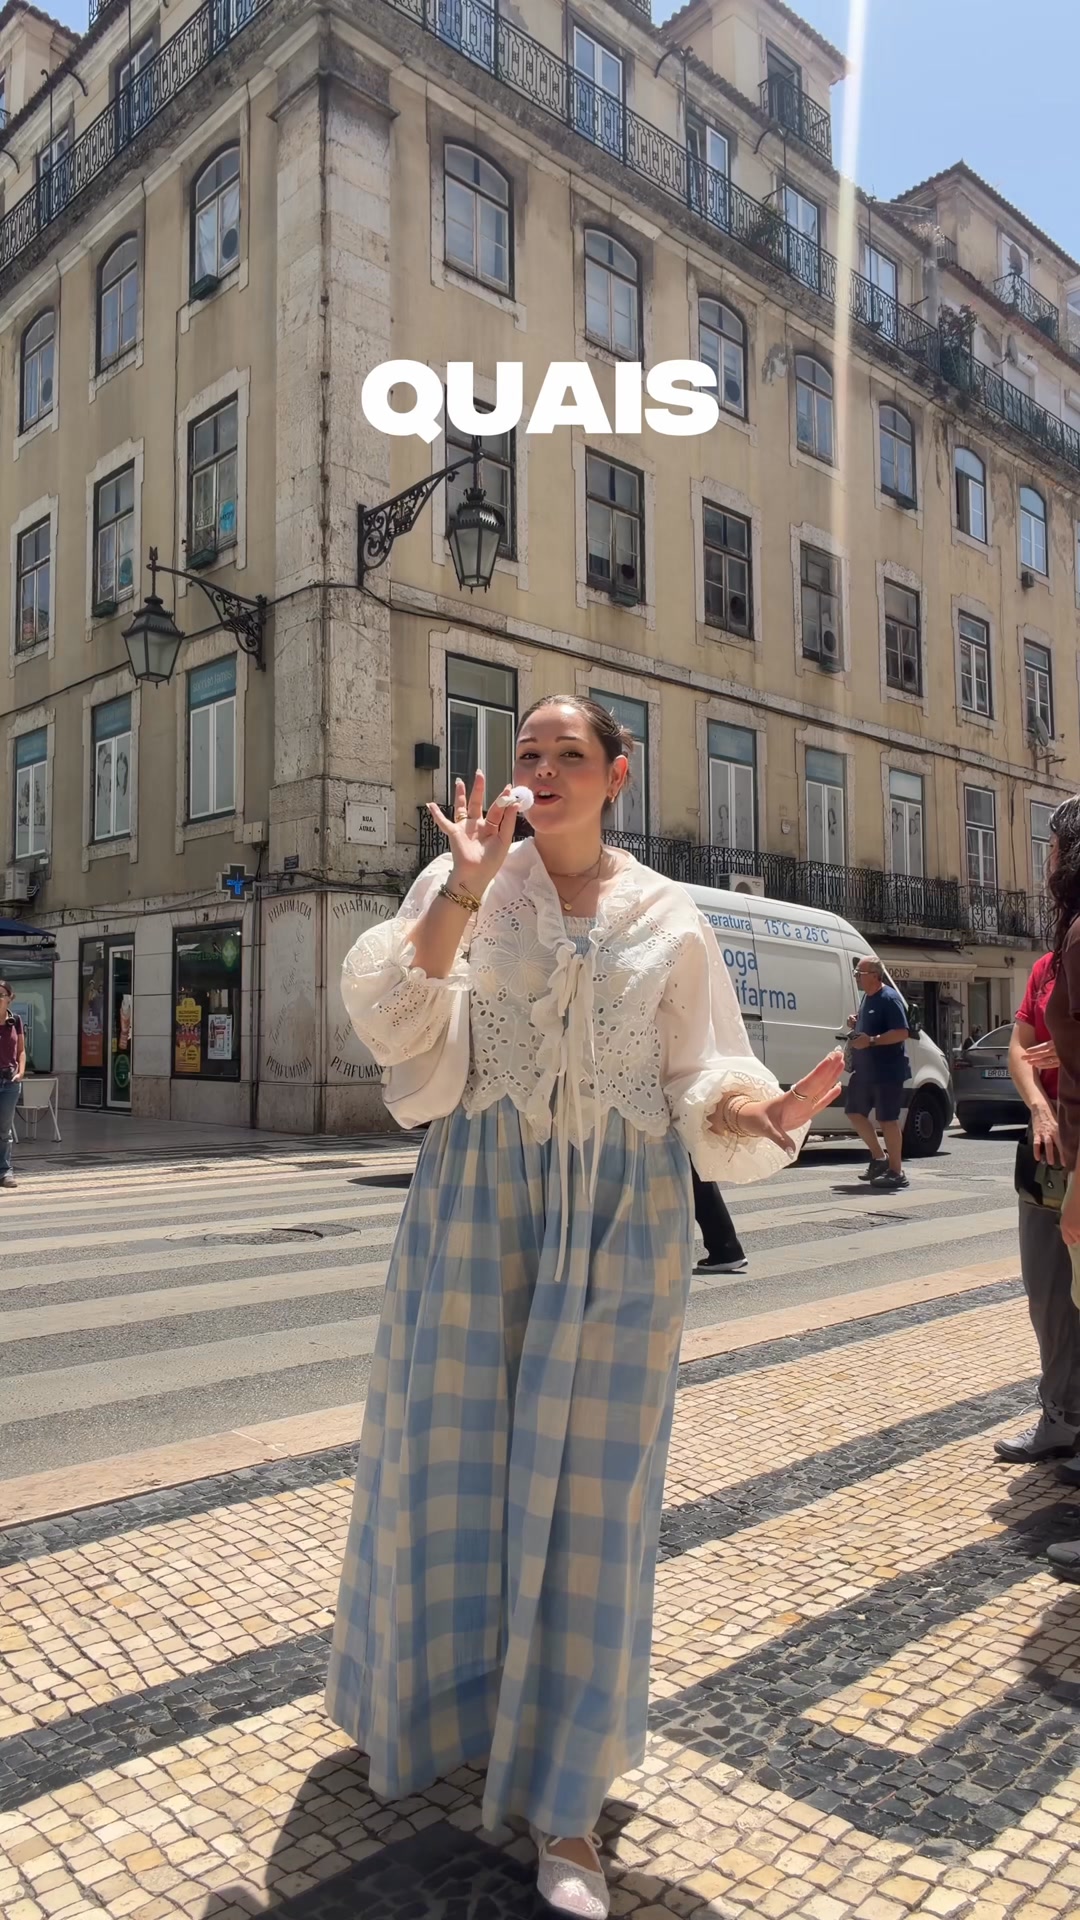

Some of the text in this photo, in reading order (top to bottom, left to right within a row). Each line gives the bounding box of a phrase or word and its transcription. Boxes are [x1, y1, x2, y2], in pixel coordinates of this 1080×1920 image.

[268, 899, 312, 923] PHARMACIA
[795, 928, 802, 940] a
[723, 948, 758, 977] oga
[735, 979, 797, 1011] ifarma
[266, 1055, 312, 1079] PERFUMARIA
